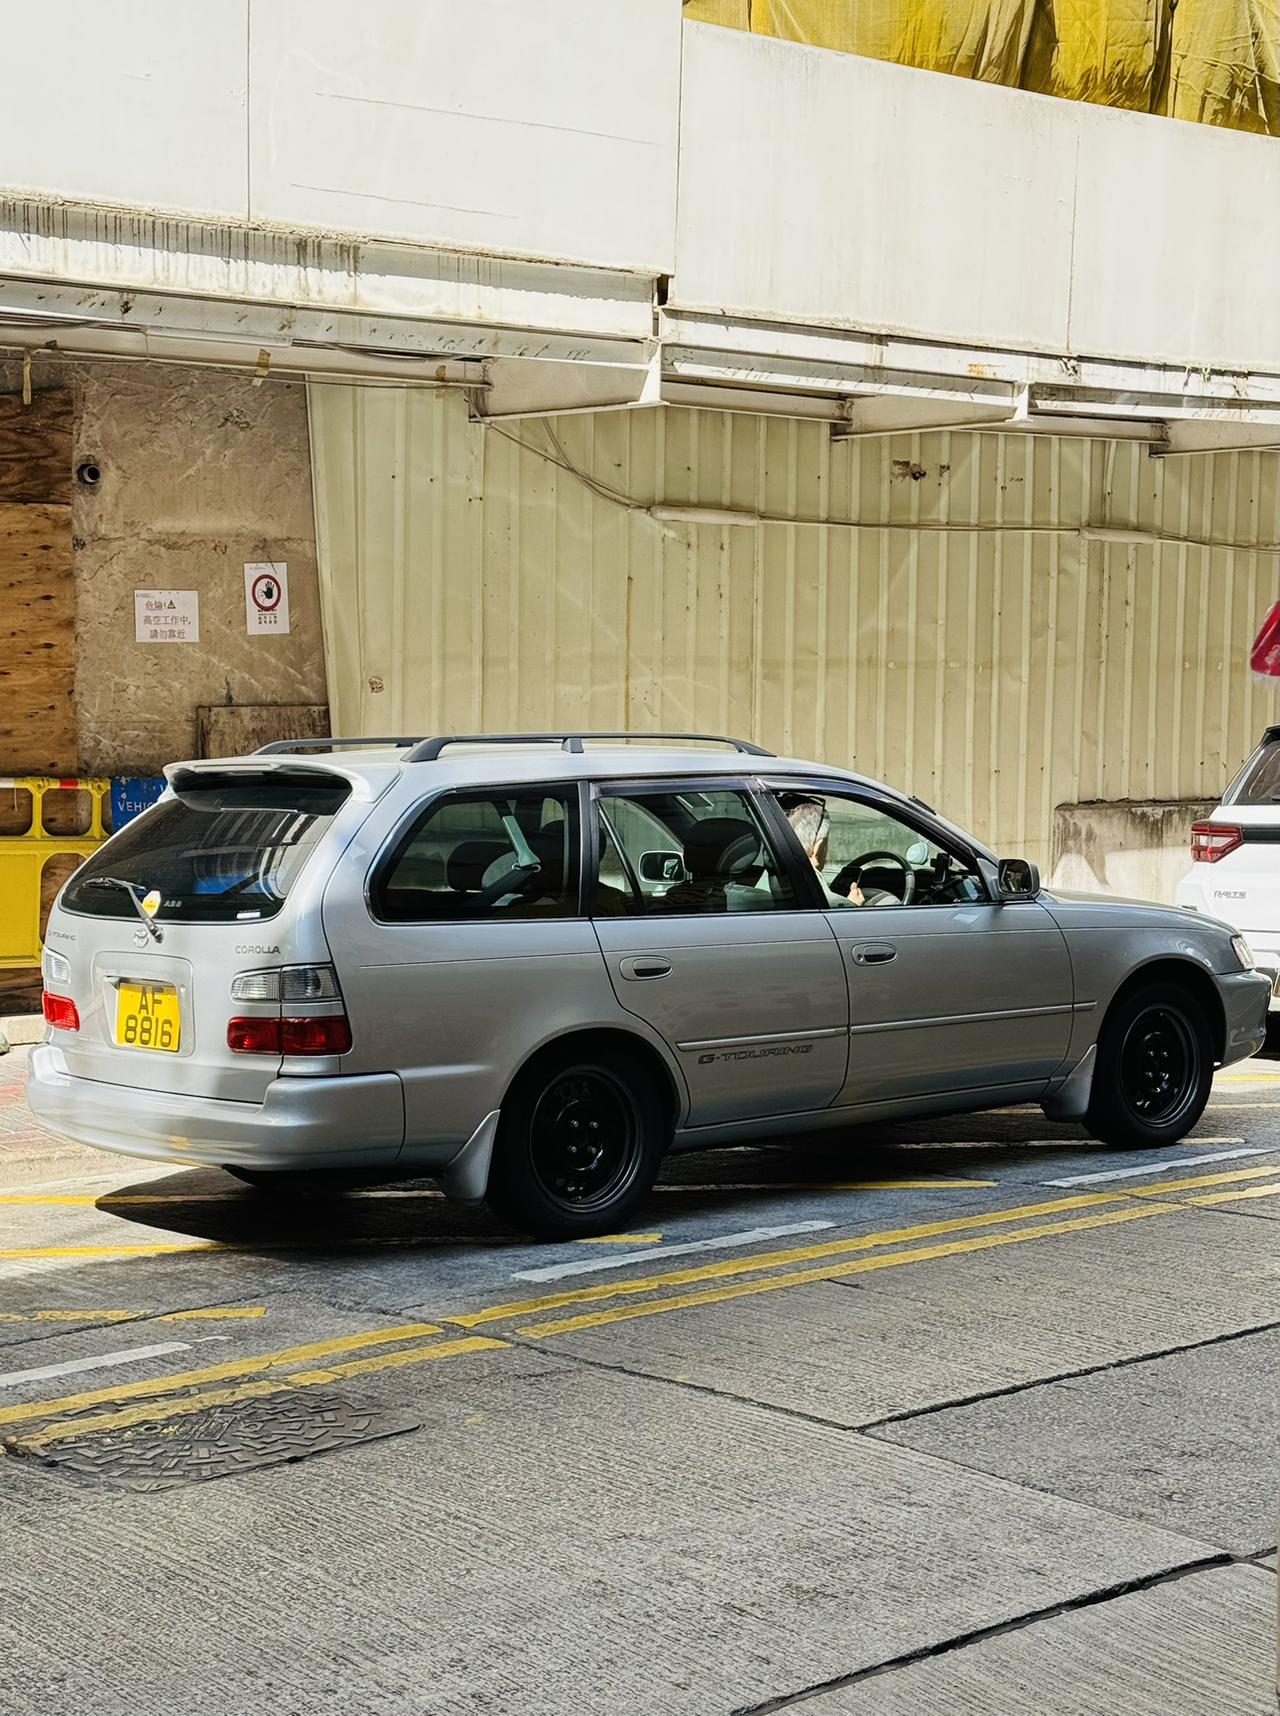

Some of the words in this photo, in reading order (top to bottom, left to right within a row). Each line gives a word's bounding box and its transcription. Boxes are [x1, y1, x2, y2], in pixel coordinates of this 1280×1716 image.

[234, 945, 281, 954] COROLLA
[138, 986, 164, 1016] AF
[124, 1014, 174, 1048] 8816
